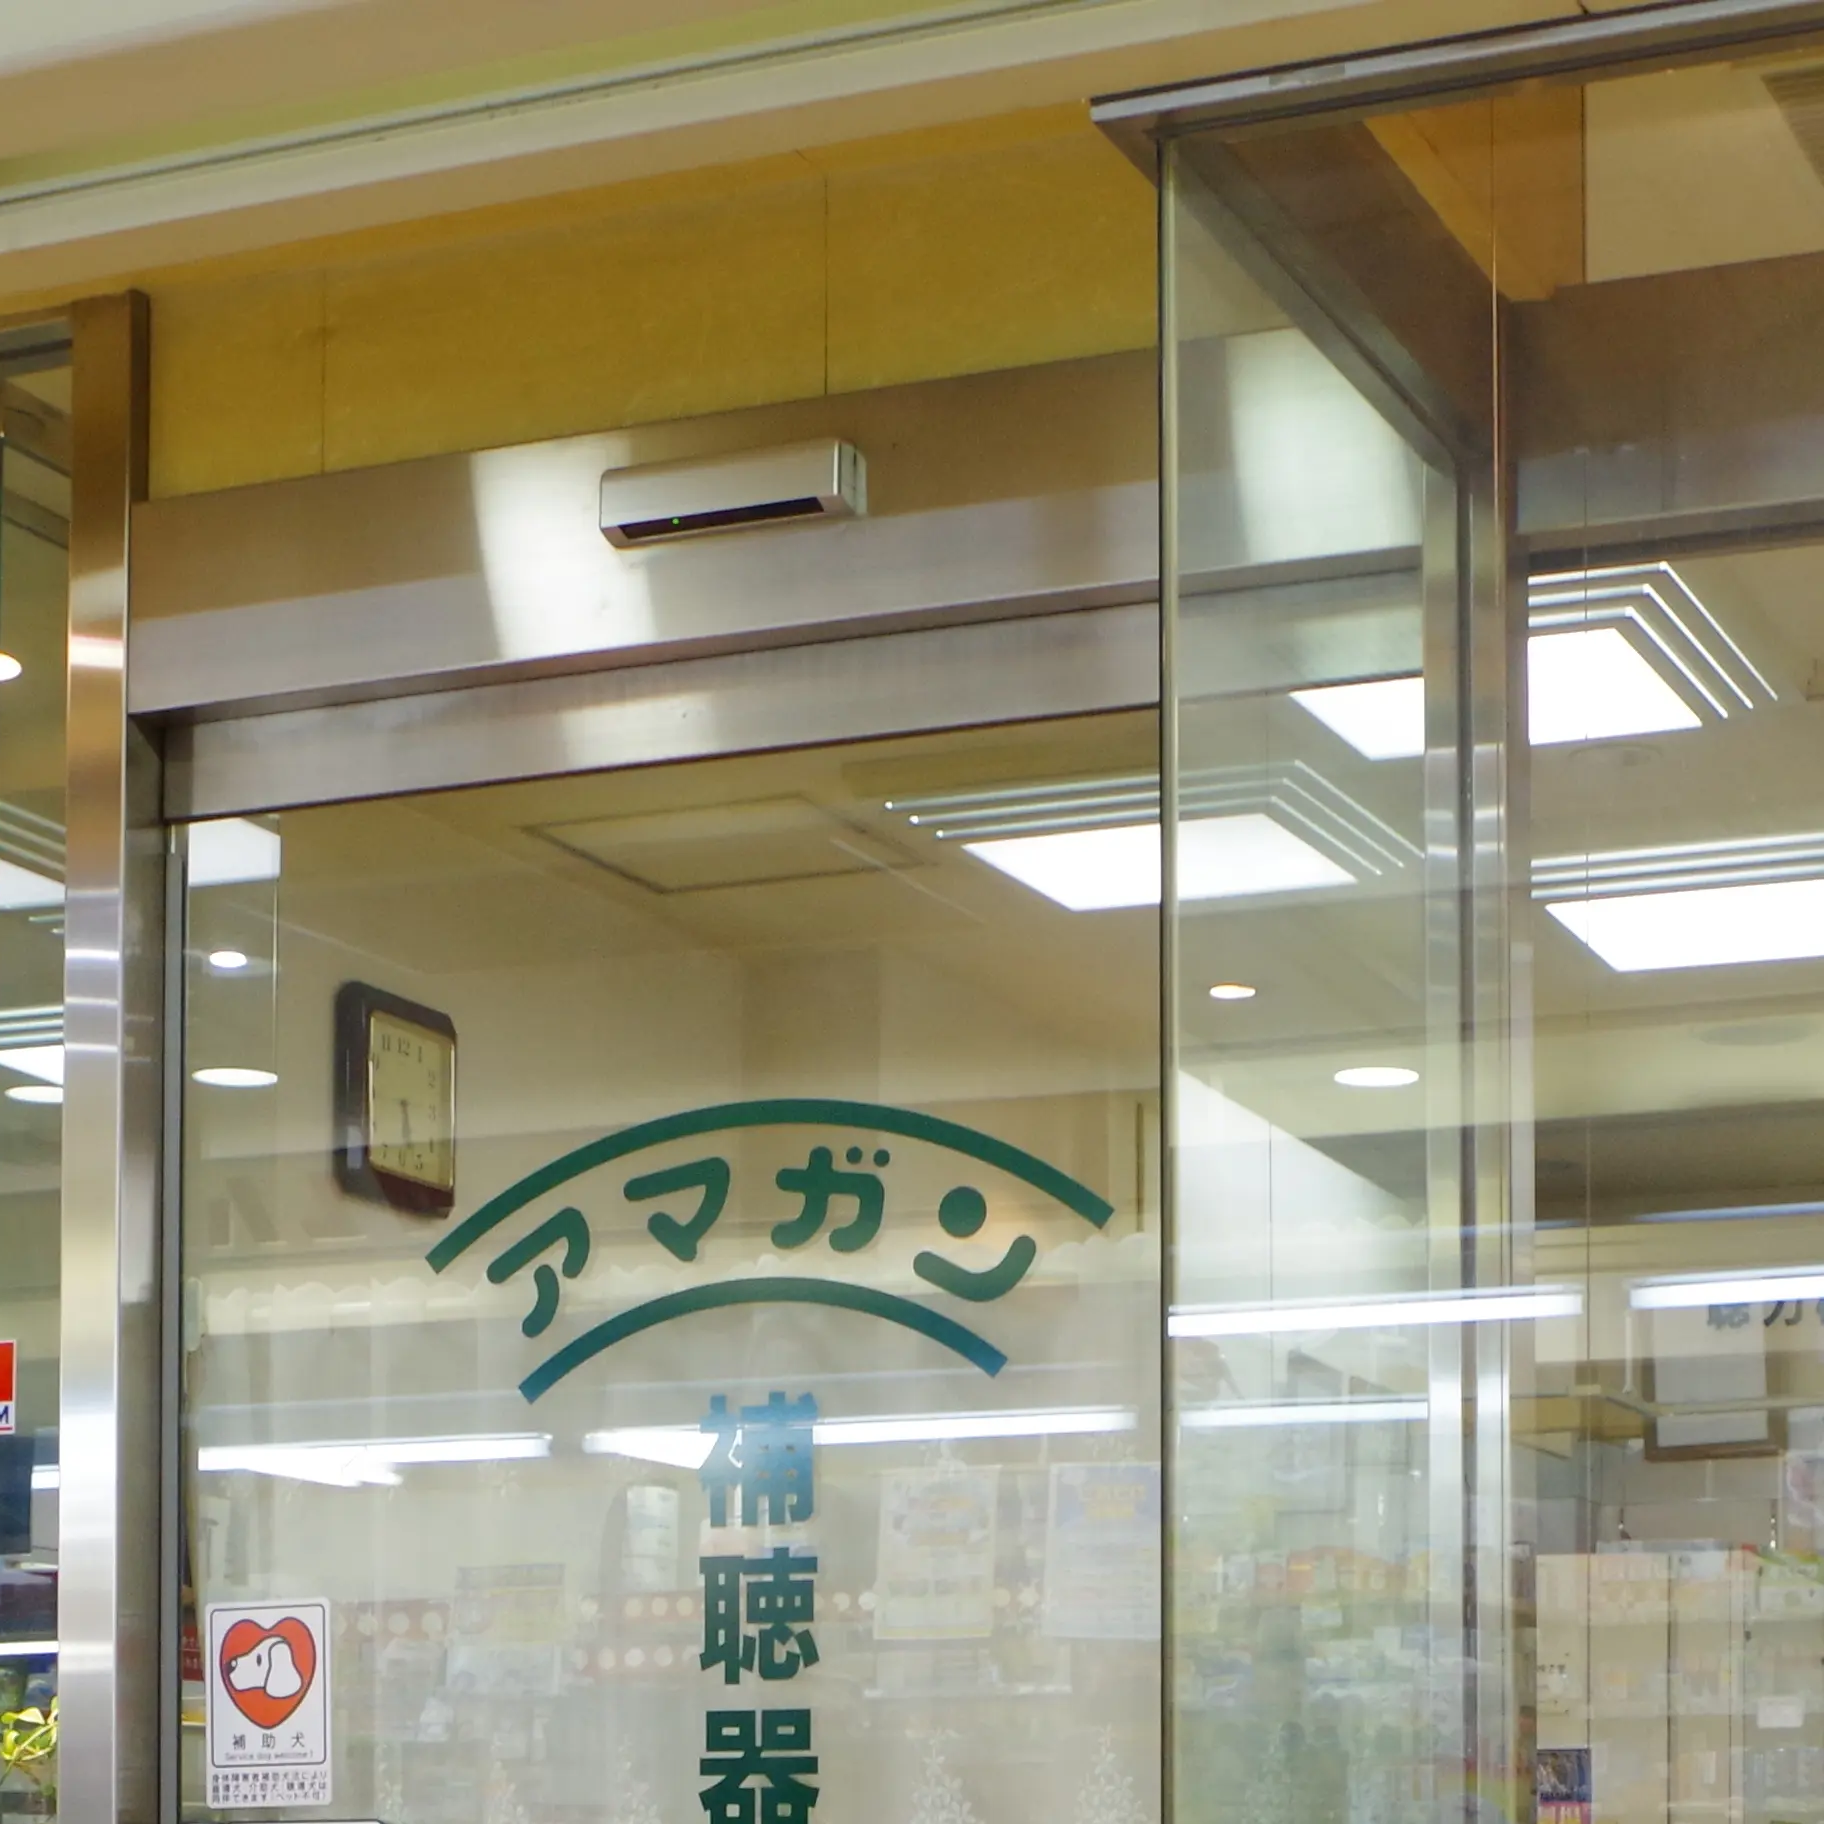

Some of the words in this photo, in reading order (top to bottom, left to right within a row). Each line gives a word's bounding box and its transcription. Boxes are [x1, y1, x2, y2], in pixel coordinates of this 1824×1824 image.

[487, 1146, 1036, 1338] アマガン
[232, 1731, 305, 1751] 補助犬
